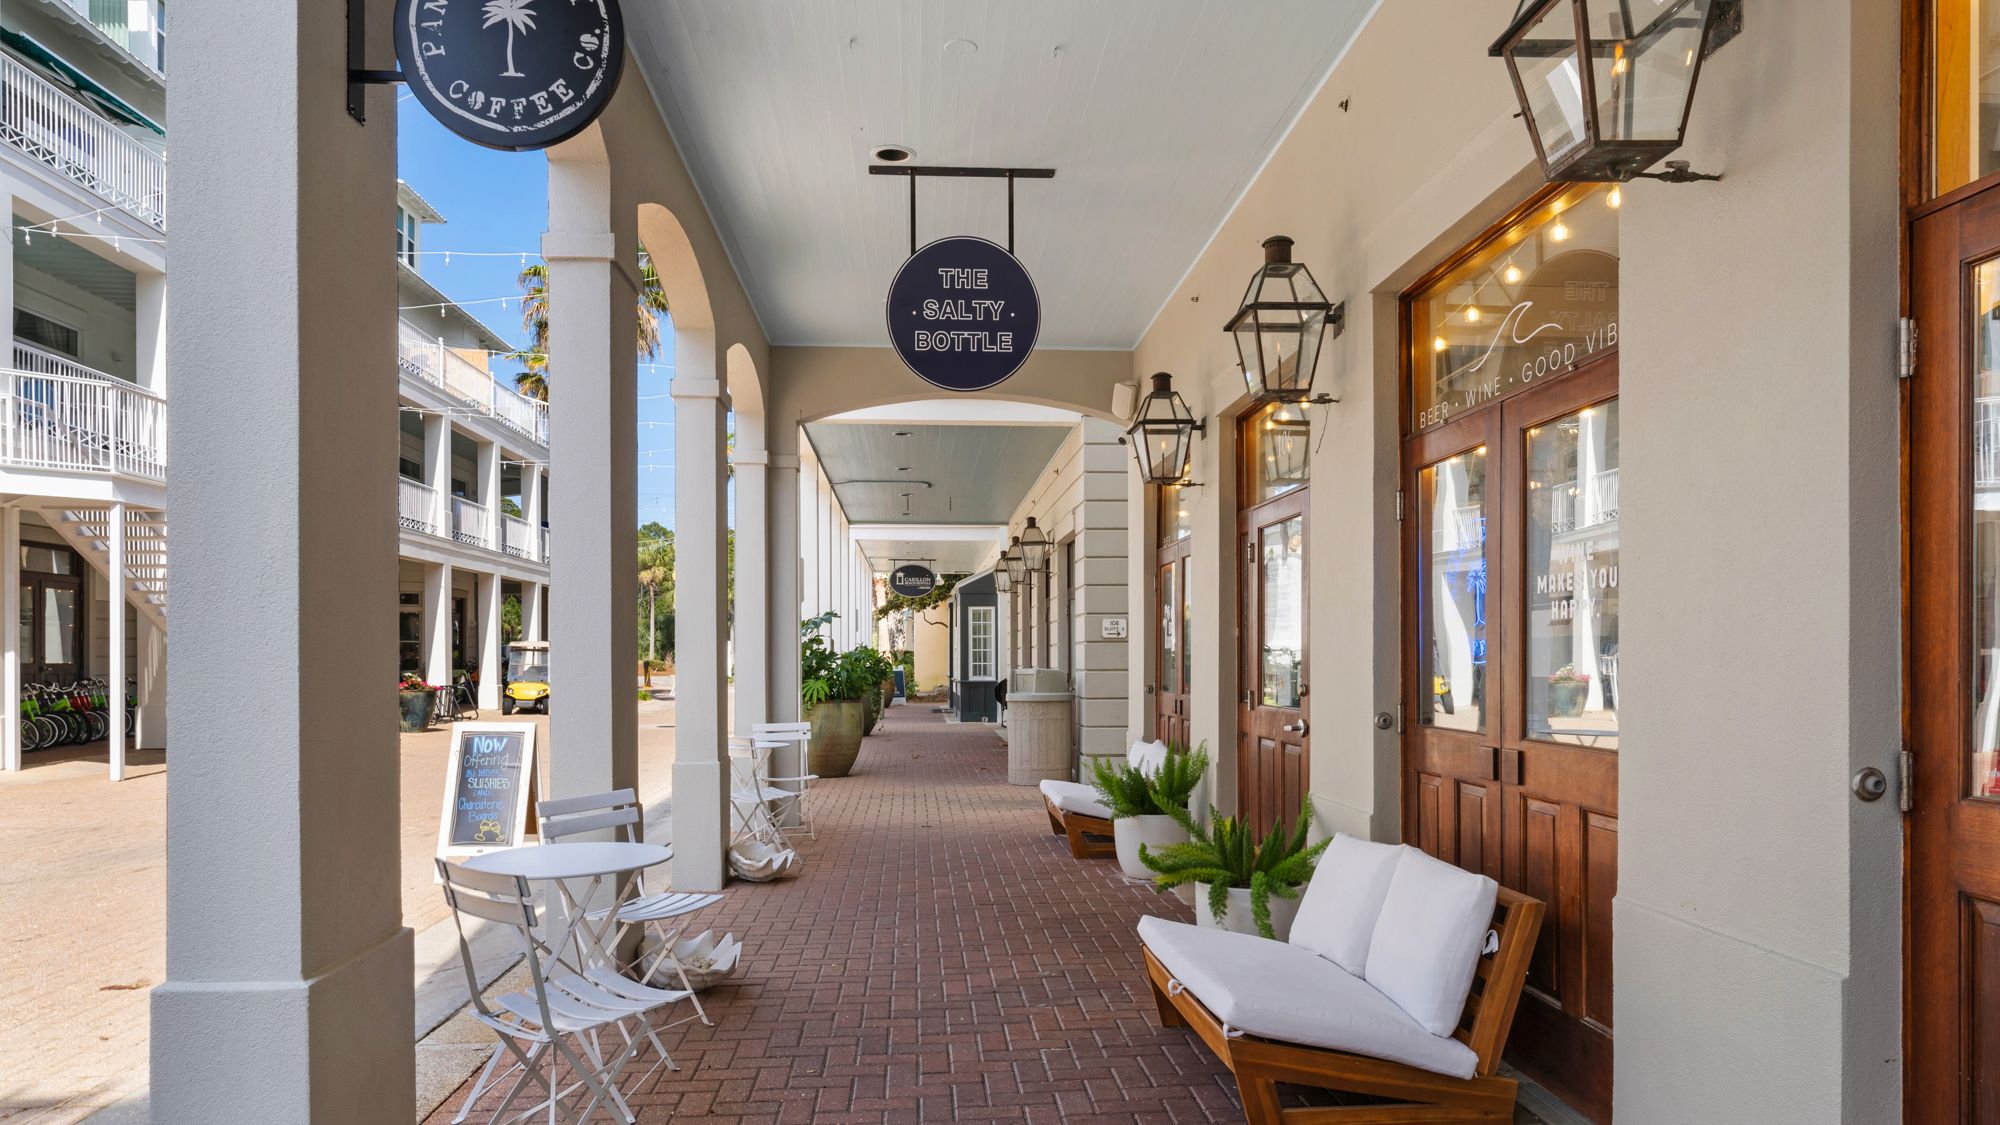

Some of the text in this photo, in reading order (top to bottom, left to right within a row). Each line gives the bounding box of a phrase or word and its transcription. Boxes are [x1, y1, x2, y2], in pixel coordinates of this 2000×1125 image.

[449, 78, 574, 119] COFFEE
[938, 268, 988, 289] THE
[923, 299, 1005, 321] SALTY
[914, 331, 1013, 353] BOTTLE
[1420, 401, 1449, 429] BEER
[1465, 376, 1501, 408] WINE
[1522, 343, 1575, 383] GOOD
[1537, 566, 1618, 594] MAKES YOU
[464, 753, 510, 769] Offering
[467, 777, 511, 790] SLUSHIES
